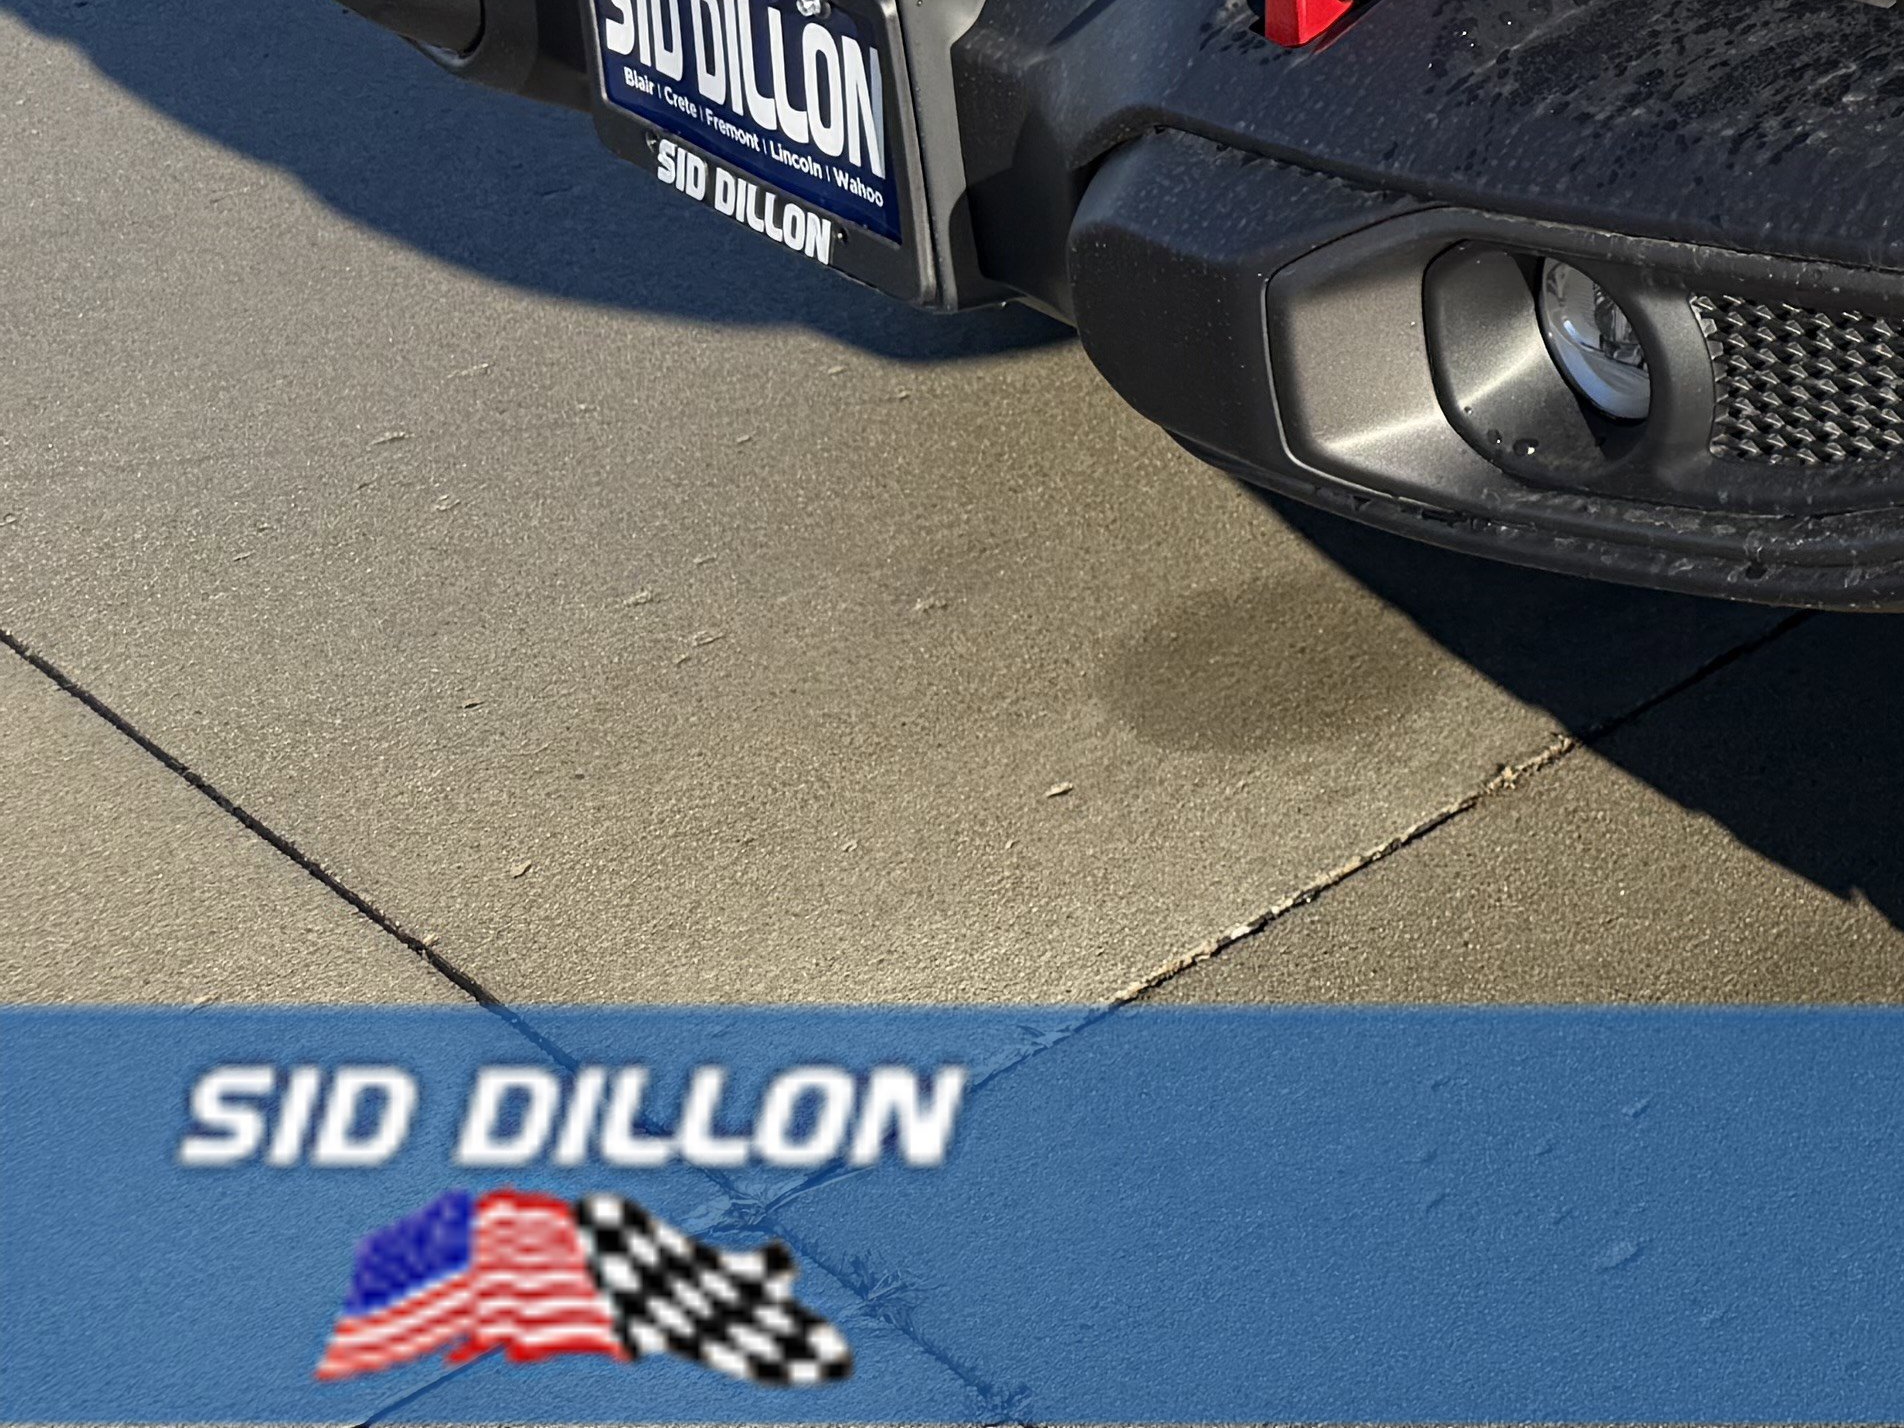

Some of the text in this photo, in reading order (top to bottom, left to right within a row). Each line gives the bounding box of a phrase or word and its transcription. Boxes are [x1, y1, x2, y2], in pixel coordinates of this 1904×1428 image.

[624, 66, 885, 208] Blair Crete Fremont Lincoln Wahoo
[657, 137, 833, 266] SID DILLON
